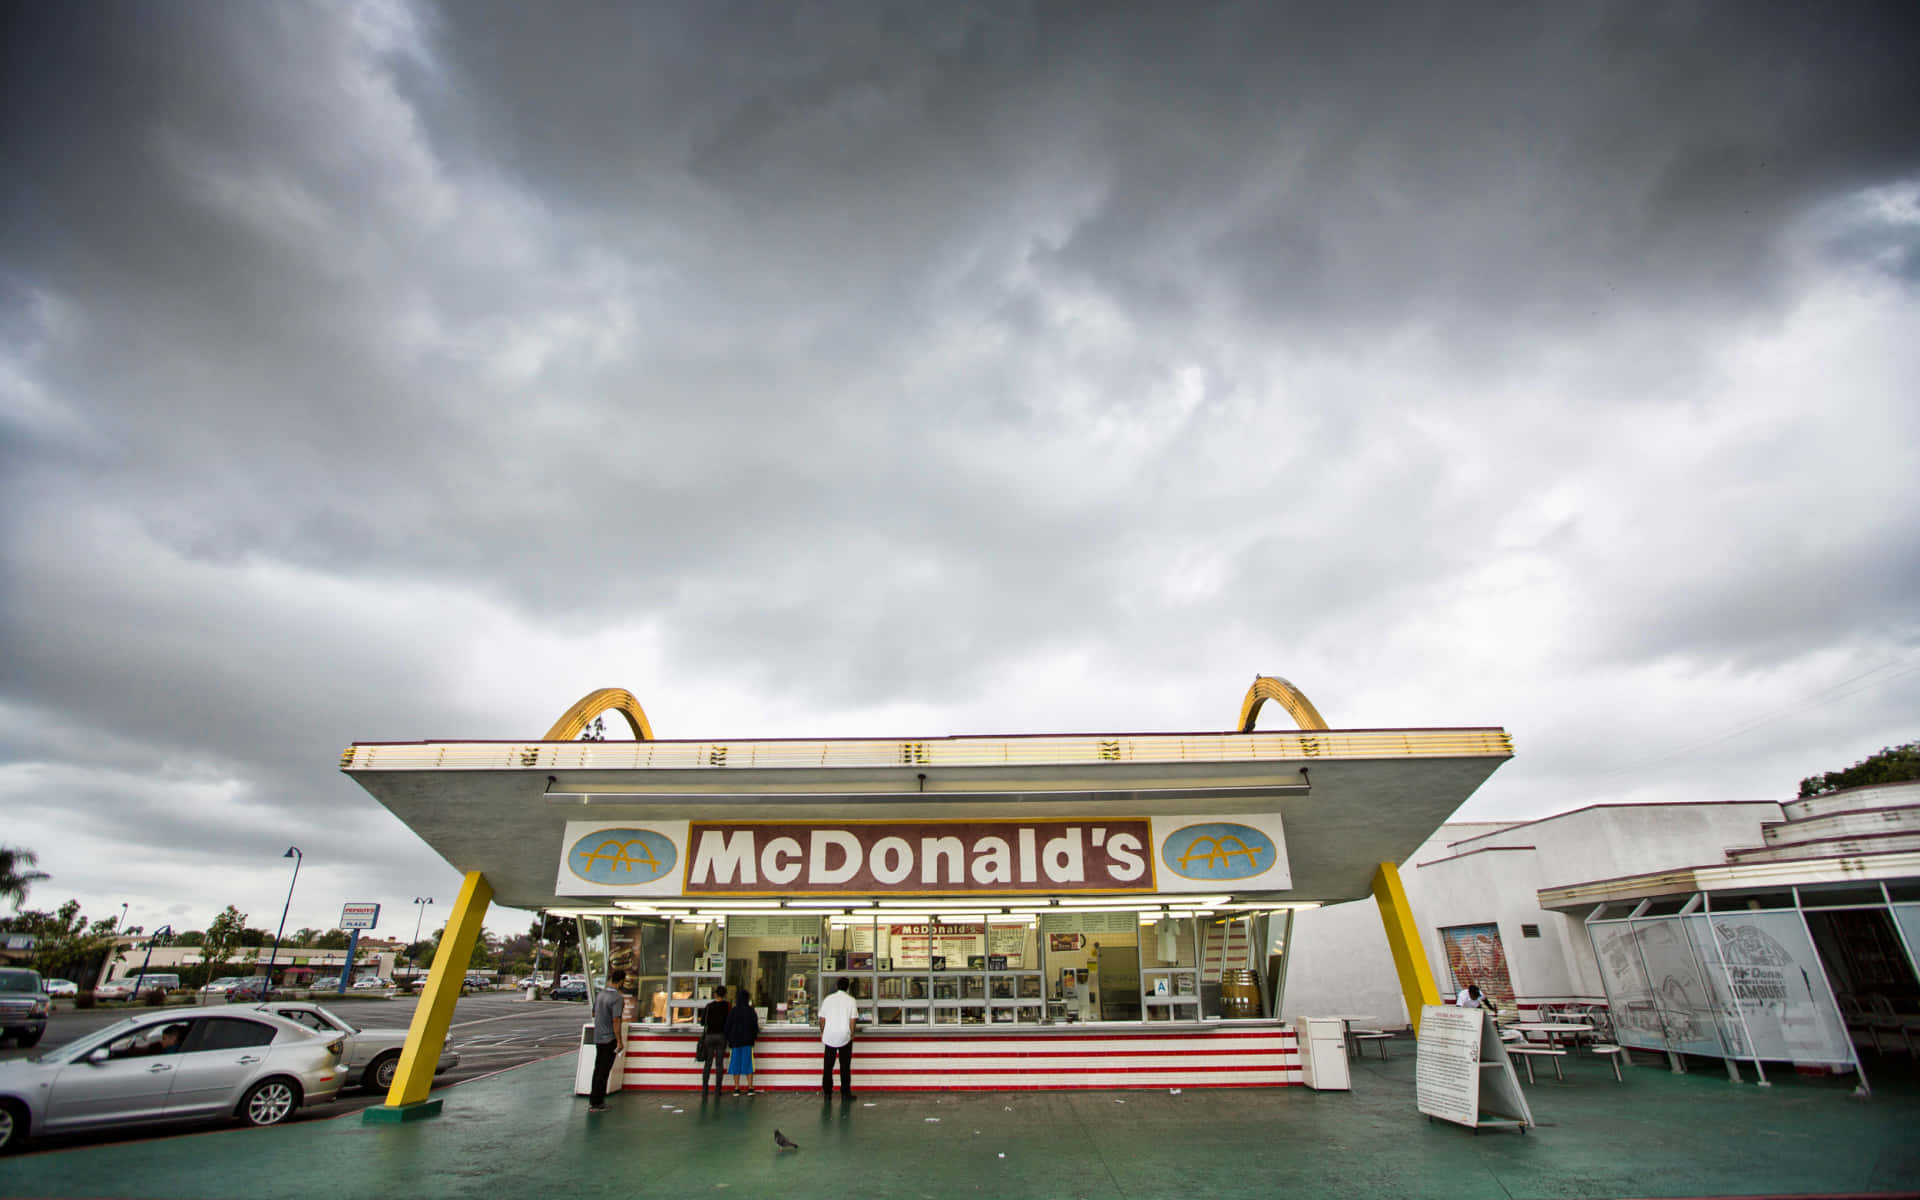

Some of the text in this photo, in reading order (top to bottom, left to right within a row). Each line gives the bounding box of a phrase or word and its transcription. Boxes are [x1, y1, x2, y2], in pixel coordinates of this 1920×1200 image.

[690, 828, 1146, 885] McDonald's
[902, 925, 977, 935] McDonald's
[1158, 982, 1166, 992] A
